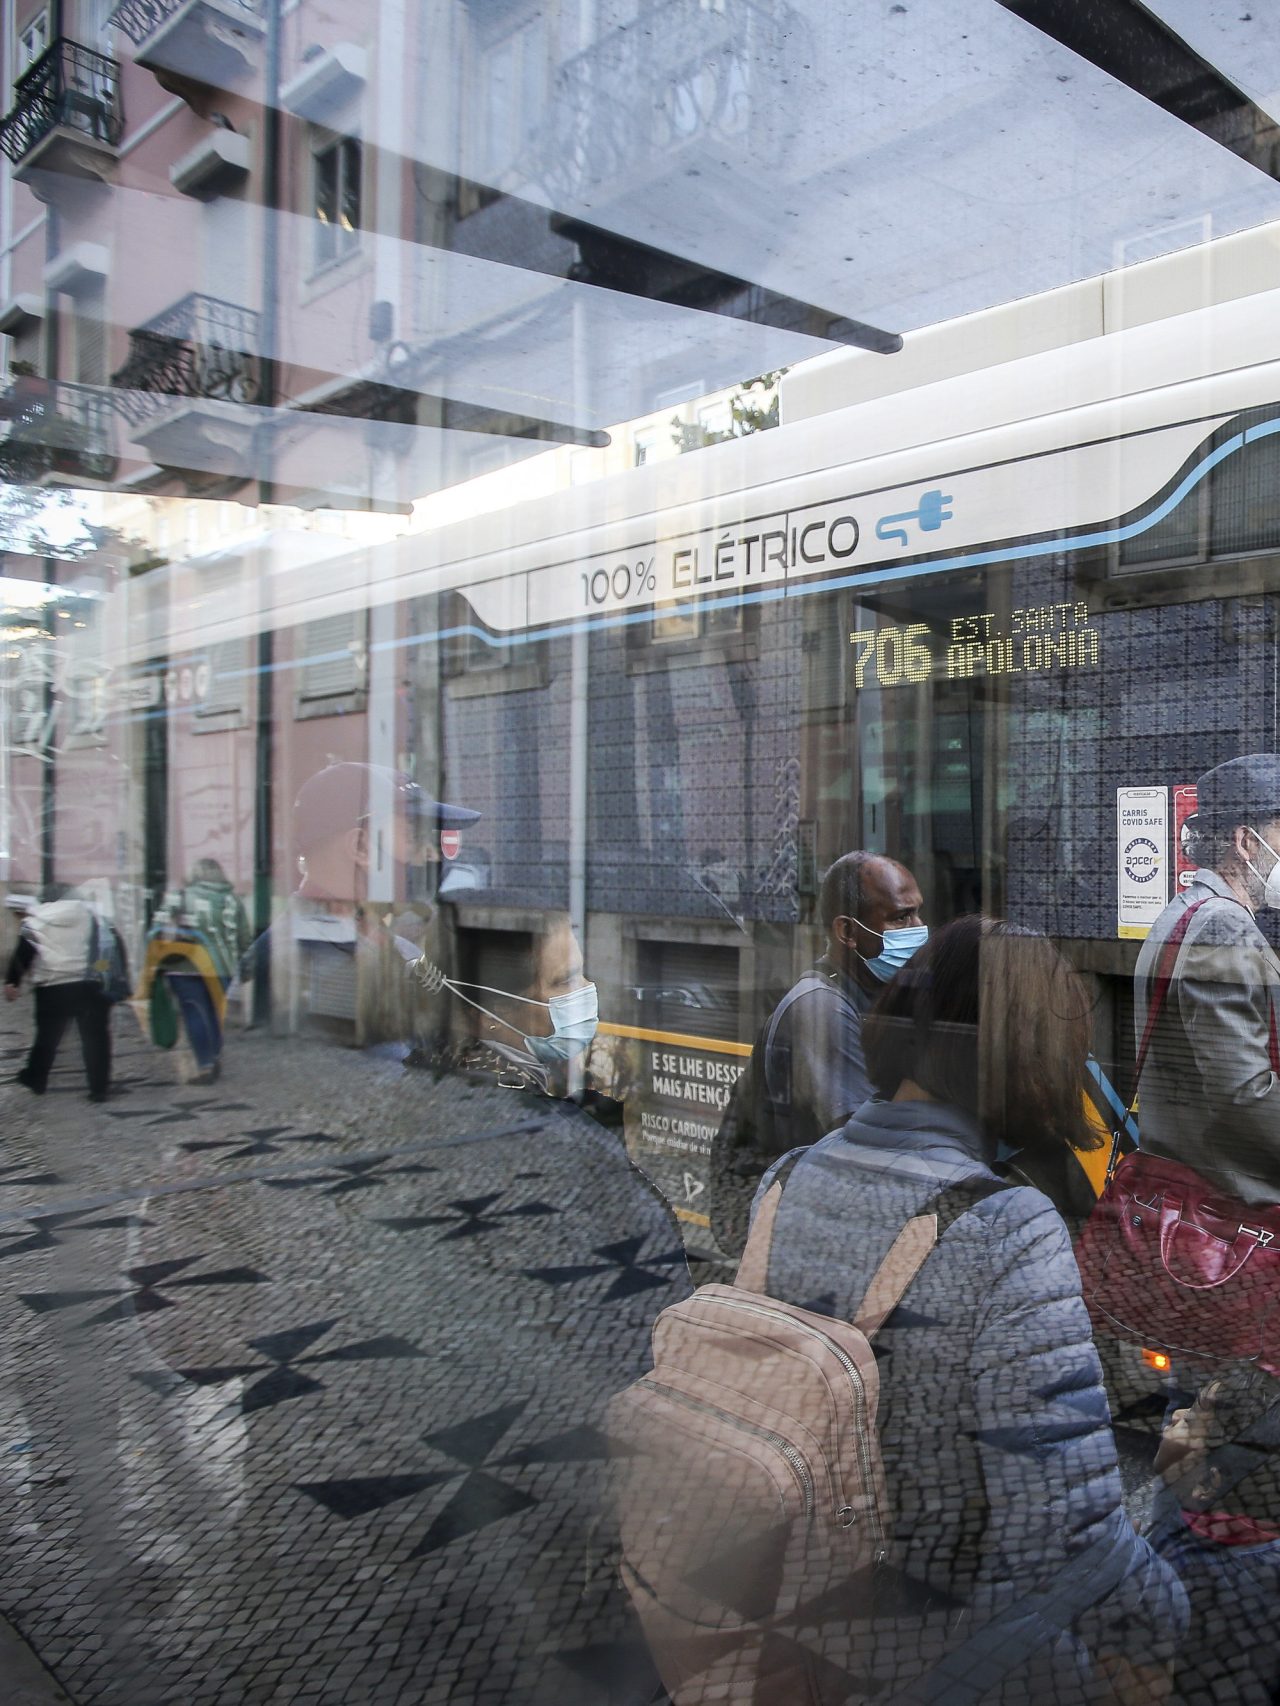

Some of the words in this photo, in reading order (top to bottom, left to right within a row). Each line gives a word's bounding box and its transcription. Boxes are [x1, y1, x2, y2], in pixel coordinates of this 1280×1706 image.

[581, 557, 656, 606] 100%
[672, 515, 860, 589] ELÉTRICO
[951, 612, 1002, 642] EST.
[1010, 601, 1089, 635] SANTA
[849, 623, 933, 689] 706
[946, 628, 1099, 679] APOLONIA
[1122, 809, 1148, 817] CARRIS
[1122, 818, 1143, 826] COVID
[1144, 818, 1163, 826] SAFE
[652, 1052, 660, 1070] E
[662, 1054, 677, 1074] SE
[679, 1057, 703, 1079] LHE
[653, 1076, 682, 1098] MAIS
[683, 1081, 730, 1111] ATENÇÃ
[641, 1112, 669, 1131] RISCO
[671, 1119, 719, 1142] CARDIOV
